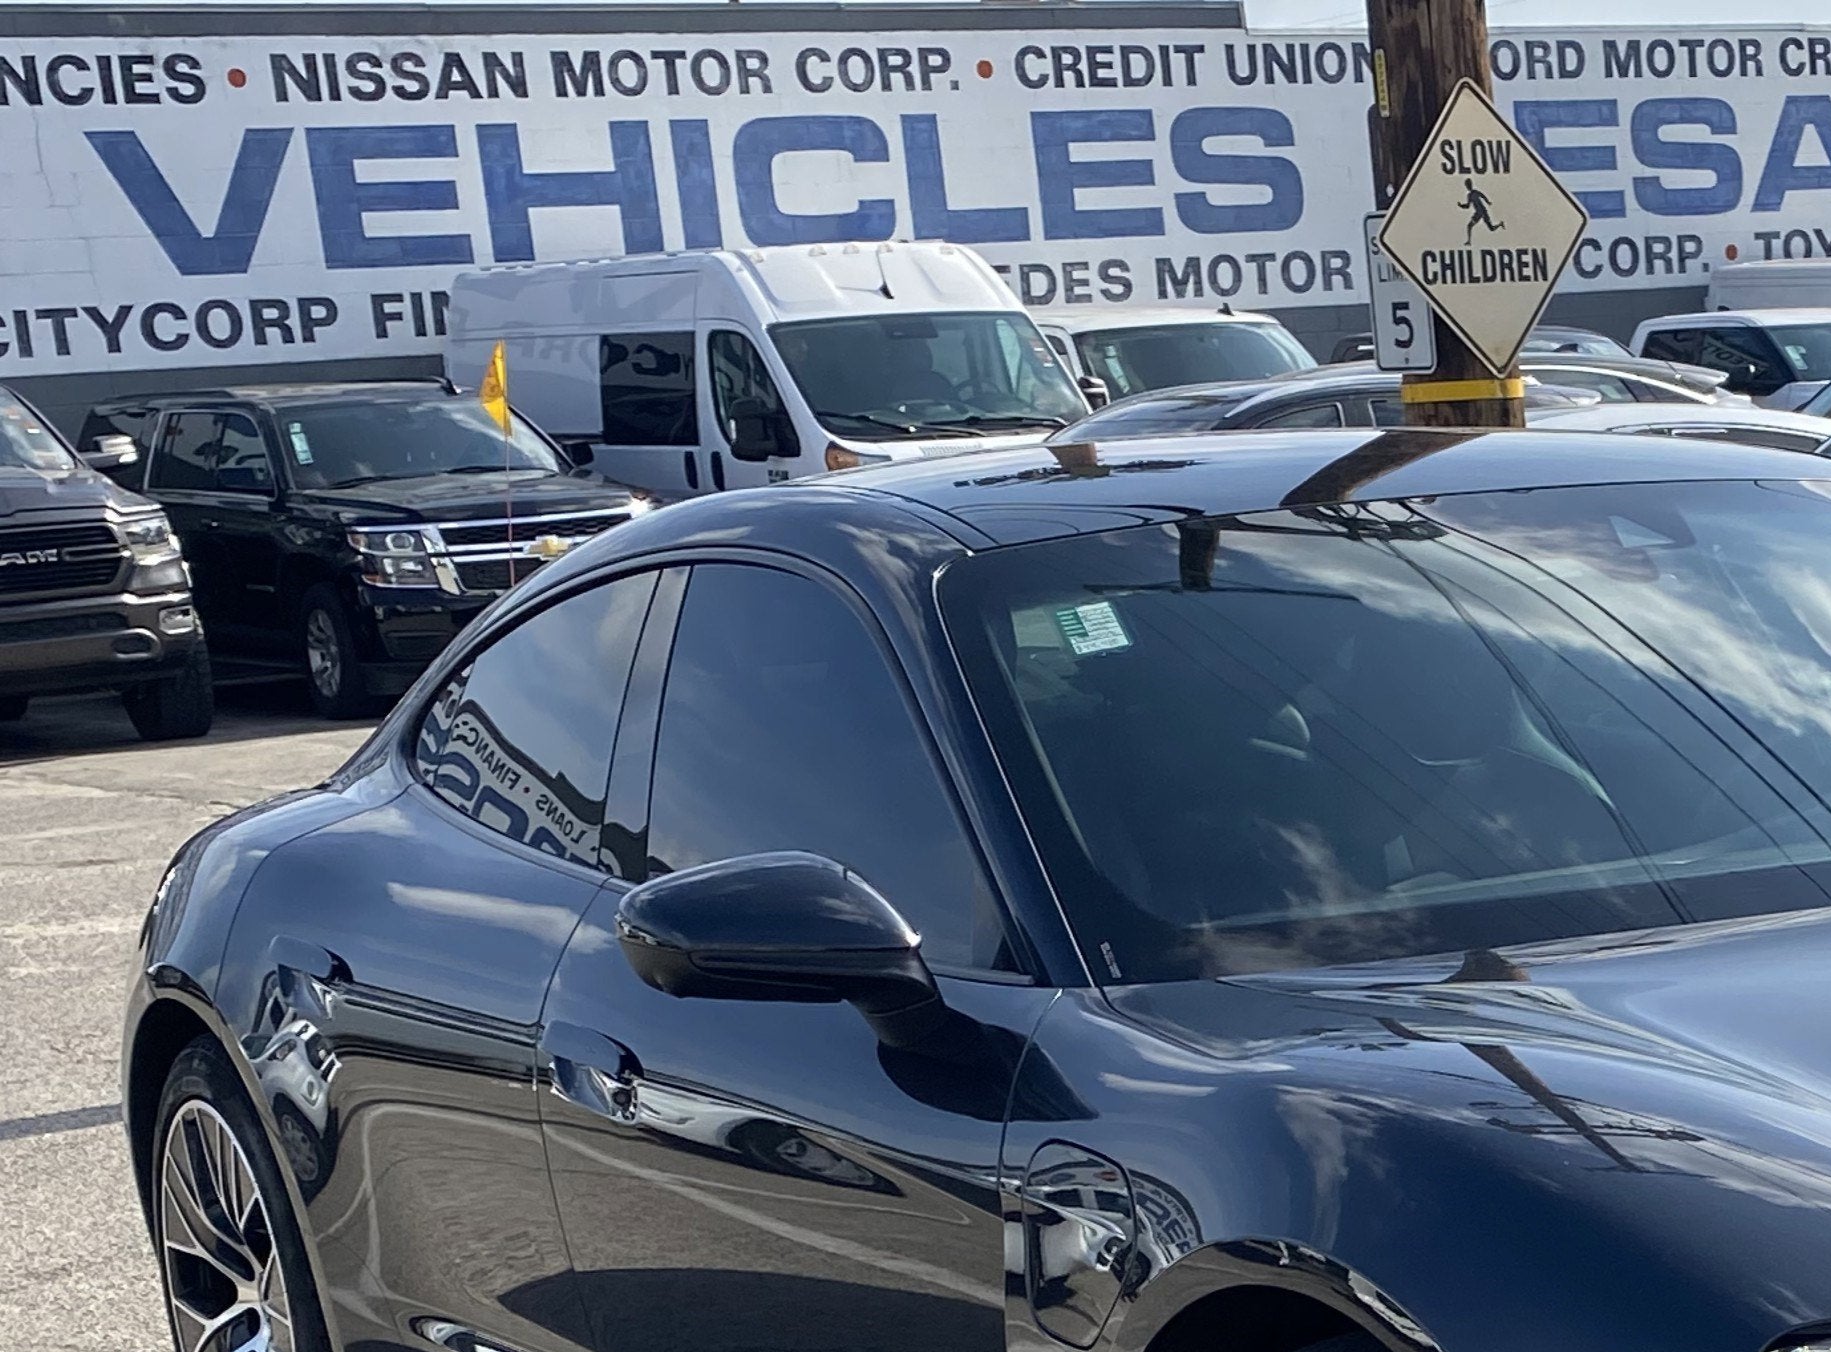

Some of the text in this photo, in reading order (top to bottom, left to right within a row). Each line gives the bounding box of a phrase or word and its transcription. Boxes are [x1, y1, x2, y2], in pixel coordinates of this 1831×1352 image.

[269, 52, 525, 102] NISSAN
[550, 49, 773, 97] MOTOR
[796, 48, 959, 94] CORP.
[1015, 44, 1205, 89] CREDIT
[1224, 42, 1371, 85] UNION
[1490, 39, 1585, 82] ORD
[1603, 39, 1763, 78] MOTOR
[1440, 139, 1511, 175] SLOW
[83, 106, 1304, 276] VEHICLES
[1155, 250, 1354, 299] MOTOR
[1573, 235, 1709, 279] CORP.
[1421, 248, 1548, 285] CHILDREN
[1391, 301, 1414, 349] 5
